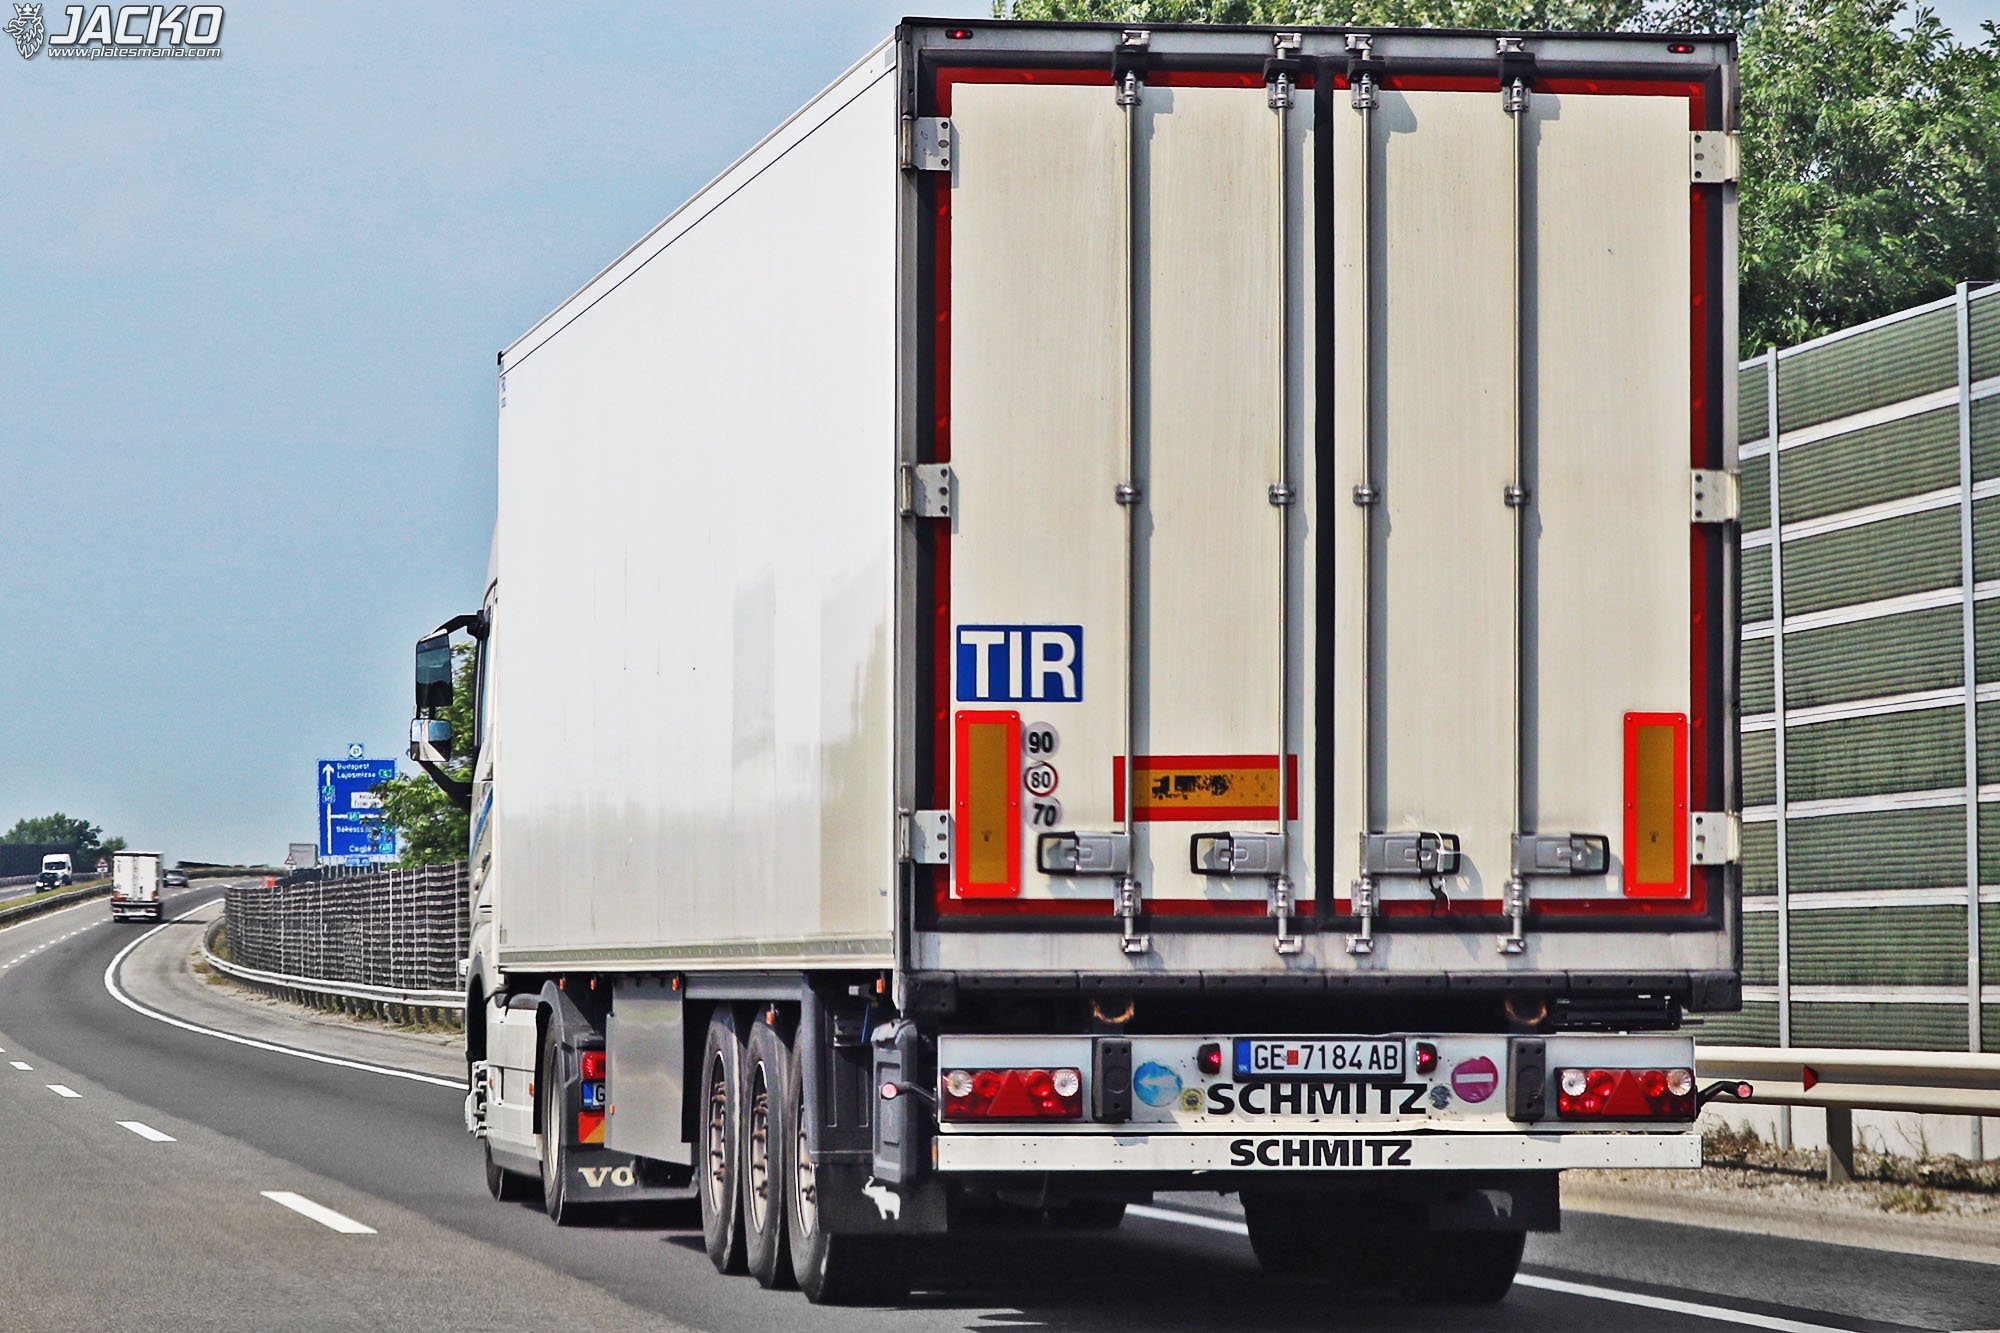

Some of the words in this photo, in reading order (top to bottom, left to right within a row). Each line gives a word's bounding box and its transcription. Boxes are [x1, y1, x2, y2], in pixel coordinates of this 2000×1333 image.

[960, 631, 1077, 699] TIR
[1028, 731, 1054, 753] 90
[1031, 771, 1051, 788] 80
[1033, 803, 1056, 826] 70
[1254, 1044, 1285, 1070] GE
[1300, 1044, 1362, 1070] 7184
[1368, 1044, 1398, 1070] AB
[1207, 1083, 1428, 1115] SCHMITZ
[1230, 1139, 1412, 1166] SCHMITZ
